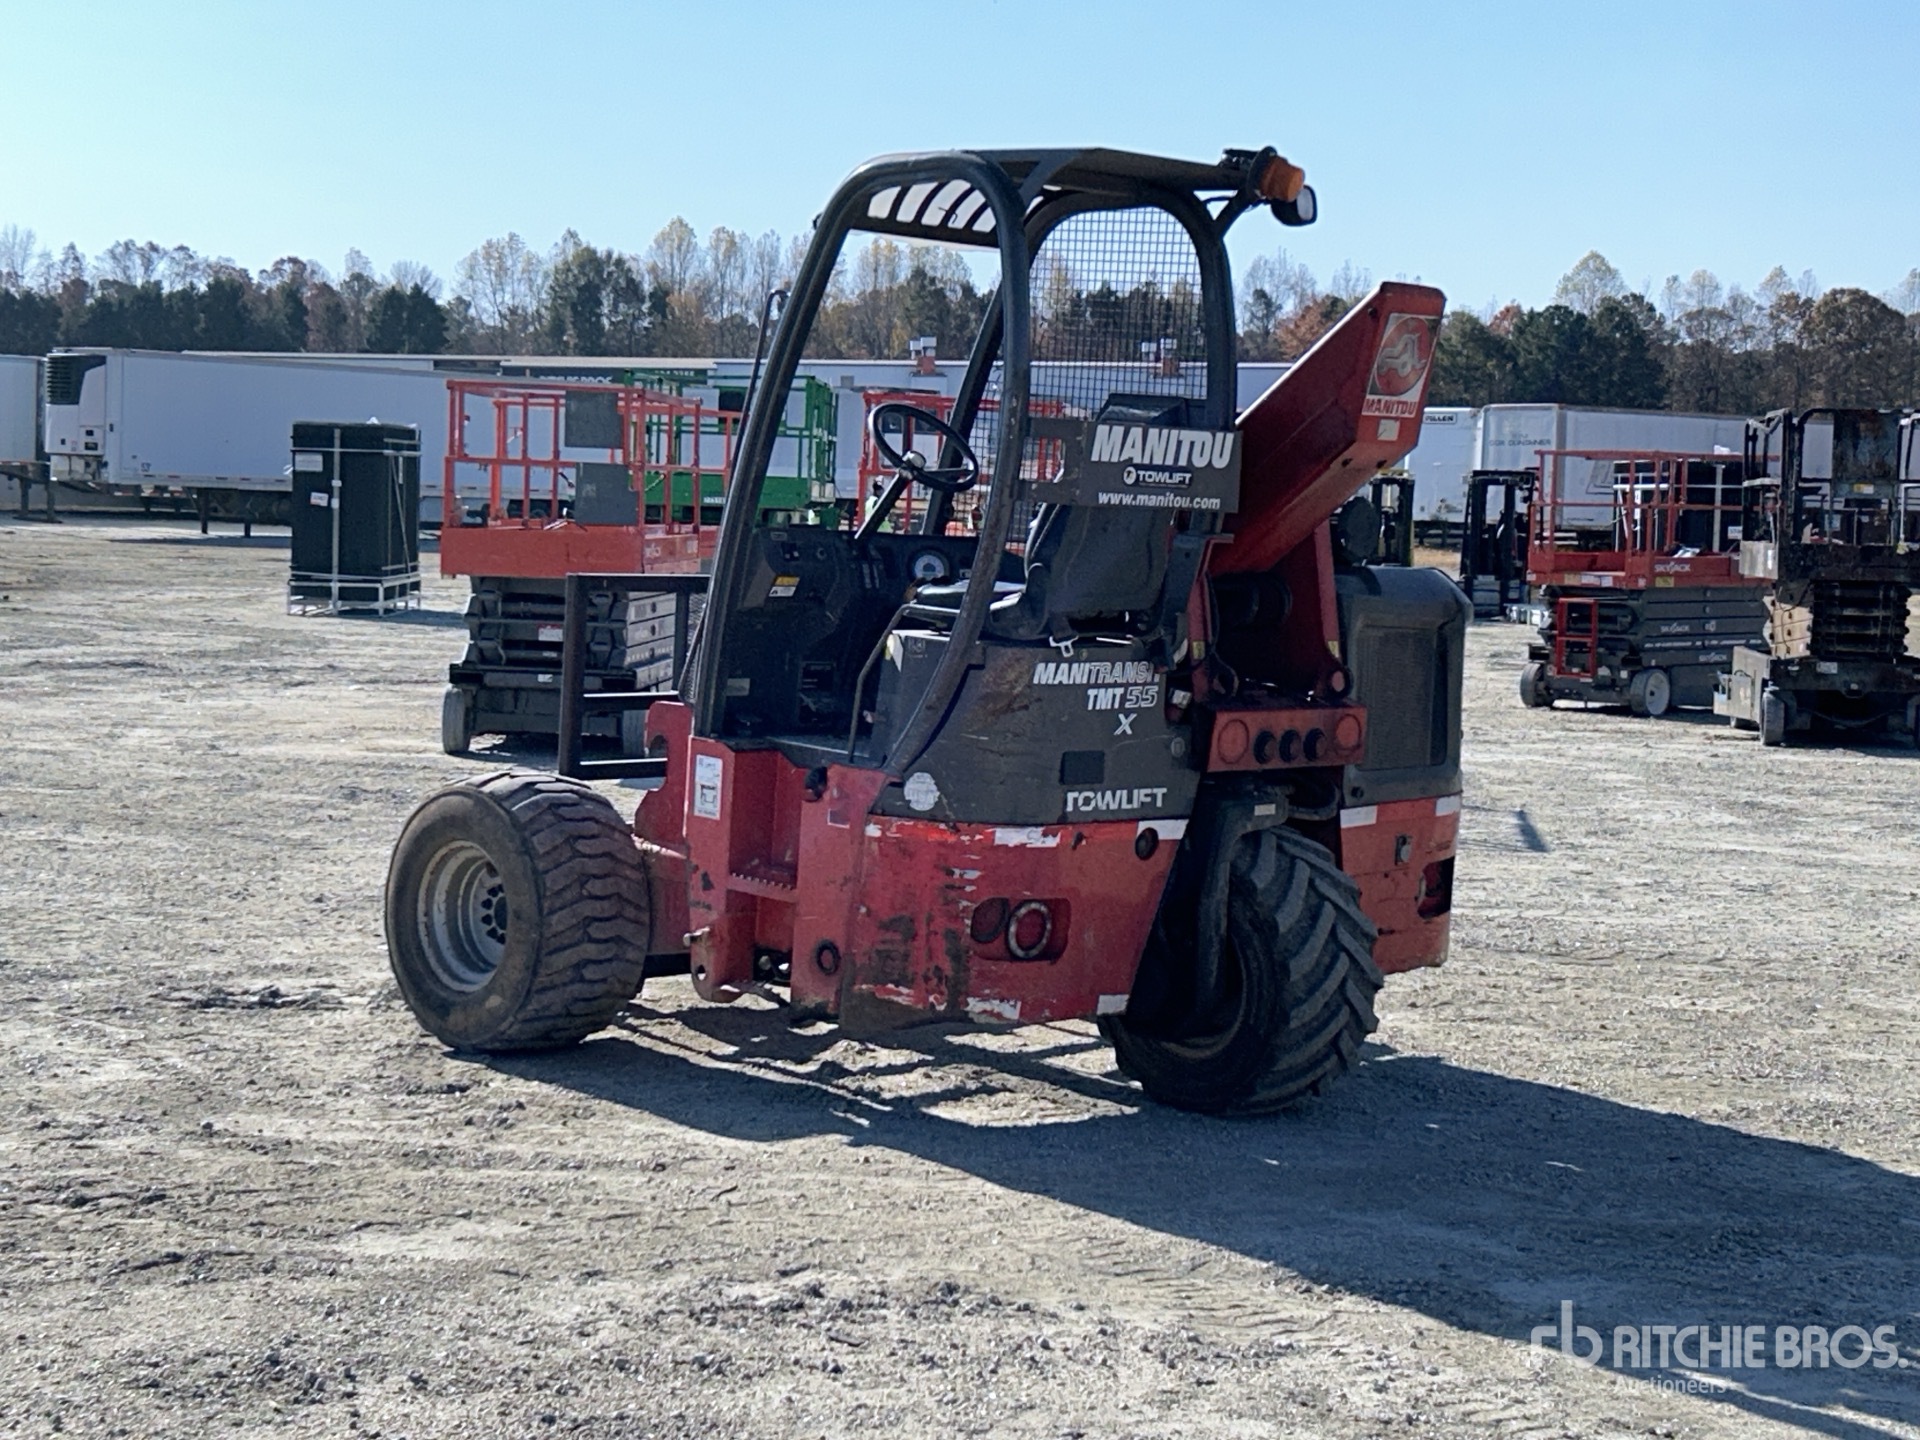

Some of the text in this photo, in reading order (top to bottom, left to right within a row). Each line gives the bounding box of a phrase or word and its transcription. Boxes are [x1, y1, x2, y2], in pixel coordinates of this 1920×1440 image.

[1365, 398, 1419, 416] MANITOU
[1091, 424, 1235, 469] MANITOU
[1137, 470, 1192, 485] TOWLIFT
[1098, 492, 1221, 510] www.manitou.com
[1654, 561, 1691, 574] SKYJACK
[1113, 713, 1138, 735] X
[1066, 787, 1168, 812] TOWLIFT
